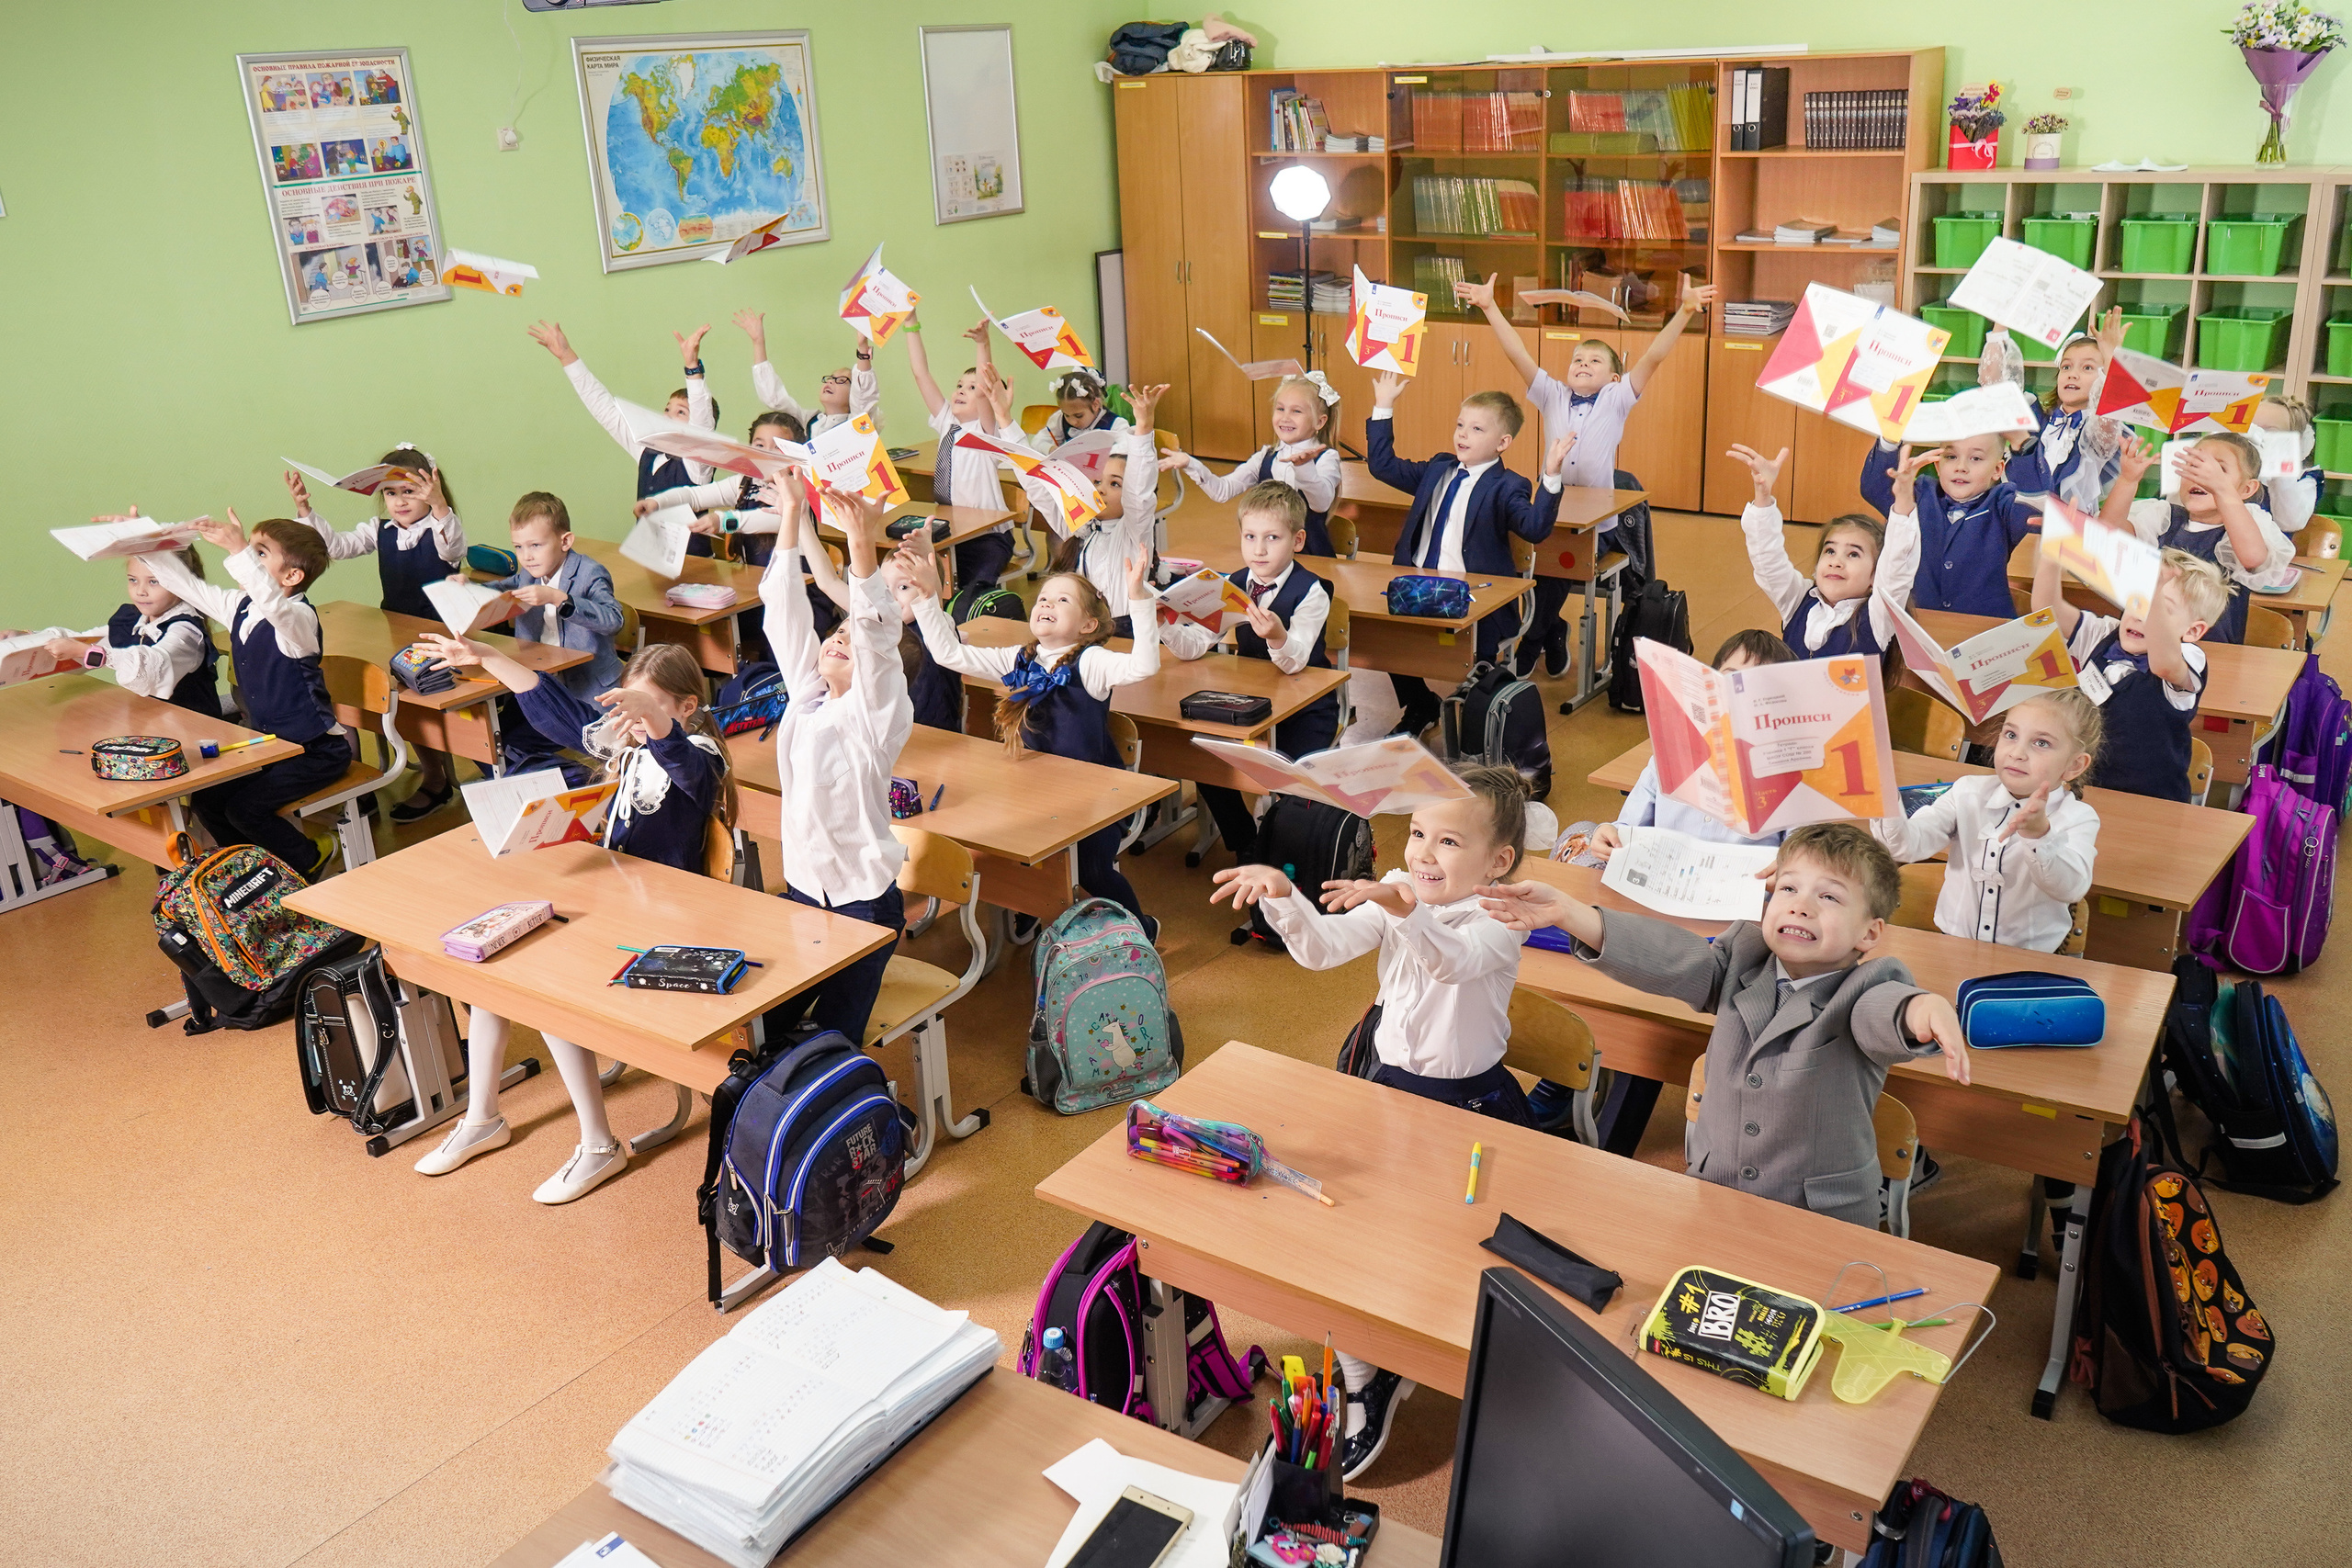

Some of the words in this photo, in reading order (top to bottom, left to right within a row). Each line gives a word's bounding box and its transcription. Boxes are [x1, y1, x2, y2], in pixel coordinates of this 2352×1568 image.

[317, 61, 350, 69] ПОЖАРНОЙ
[282, 186, 326, 197] ОСНОВНЫЕ
[327, 183, 368, 193] ДЕЙСТВИЯ
[368, 179, 384, 187] ПРИ
[385, 176, 416, 186] ПОЖАРЕ
[872, 286, 897, 308] Прописи
[1374, 308, 1408, 321] Прописи
[875, 315, 897, 339] 1
[1020, 325, 1054, 339] Прописи
[1060, 334, 1087, 356] 1
[1399, 333, 1415, 364] 1
[1868, 339, 1913, 367] Прописи
[2195, 389, 2240, 398] Прописи
[1883, 385, 1916, 426] 1
[2226, 404, 2249, 425] 1
[827, 450, 865, 473] Прописи
[871, 461, 900, 492] 1
[1182, 589, 1216, 607] Прописи
[1226, 592, 1250, 613] 1
[1971, 643, 2030, 671] Прописи
[2031, 649, 2069, 682] 1
[1754, 713, 1832, 731] Прописи
[1831, 739, 1875, 797] 1
[570, 787, 606, 809] 1
[1754, 788, 1777, 796] Часть
[1757, 796, 1767, 809] 3
[528, 809, 553, 843] Прописи
[223, 866, 275, 909] MINECRAFT
[658, 977, 693, 989] Space
[845, 1122, 873, 1148] FUTURE
[852, 1143, 876, 1168] STAR
[1679, 1282, 1706, 1314] #1
[1703, 1292, 1739, 1339] BRO
[1683, 1353, 1694, 1363] IS
[1697, 1358, 1722, 1372] THIS
